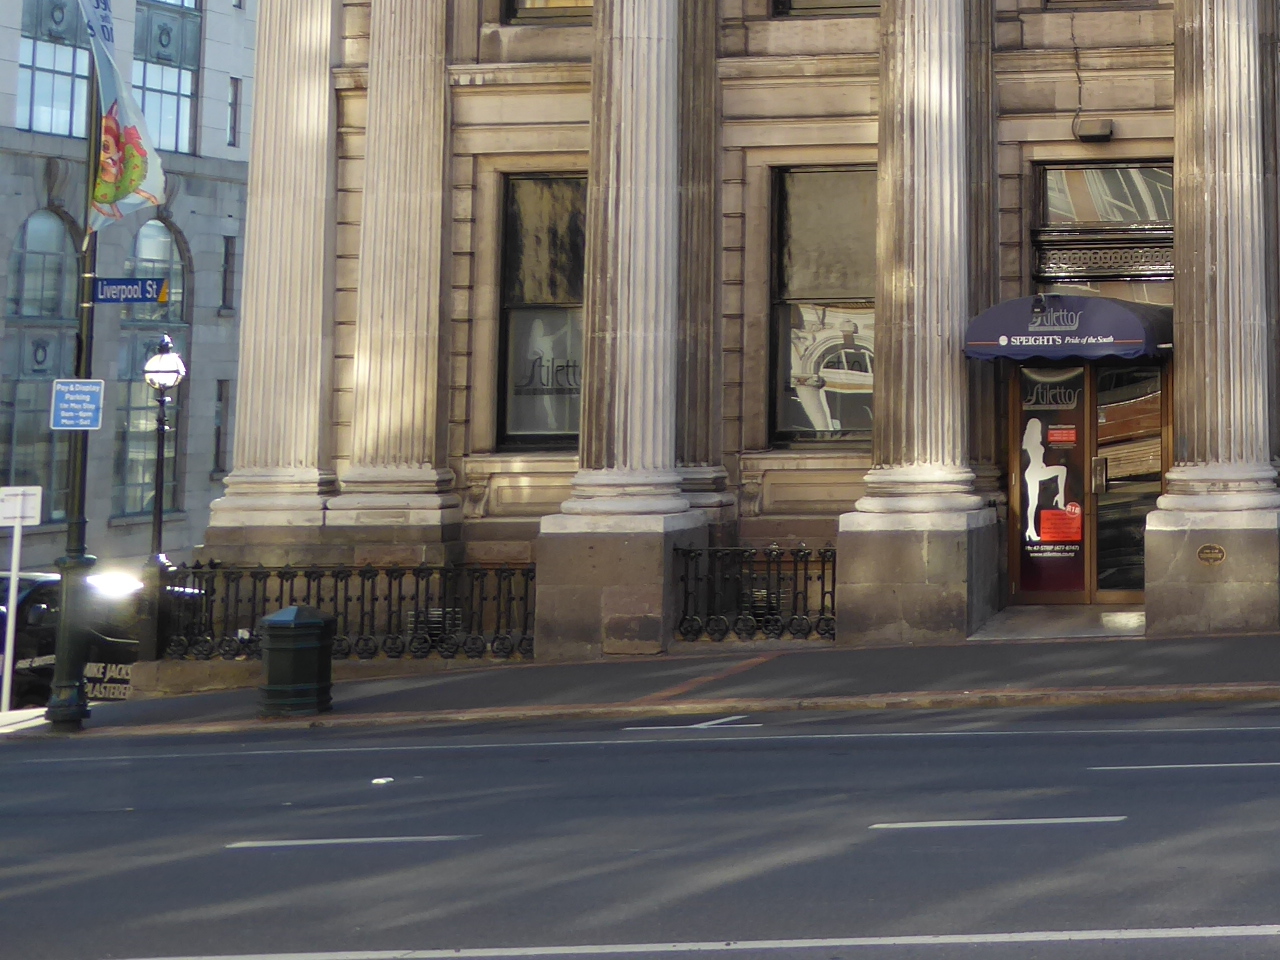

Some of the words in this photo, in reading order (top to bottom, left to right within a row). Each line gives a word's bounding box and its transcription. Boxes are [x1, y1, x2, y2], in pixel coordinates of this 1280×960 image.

[98, 281, 142, 301] Liverpool
[145, 280, 157, 299] St
[1010, 335, 1062, 345] SPEIGHT'S
[1064, 336, 1081, 344] Pride
[1080, 336, 1089, 345] of
[1088, 335, 1097, 343] the
[1096, 335, 1114, 343] South
[514, 356, 581, 388] Stilett
[56, 383, 69, 392] Pay
[75, 384, 100, 392] Display
[1022, 383, 1083, 407] Stilettos
[65, 393, 91, 401] Parking
